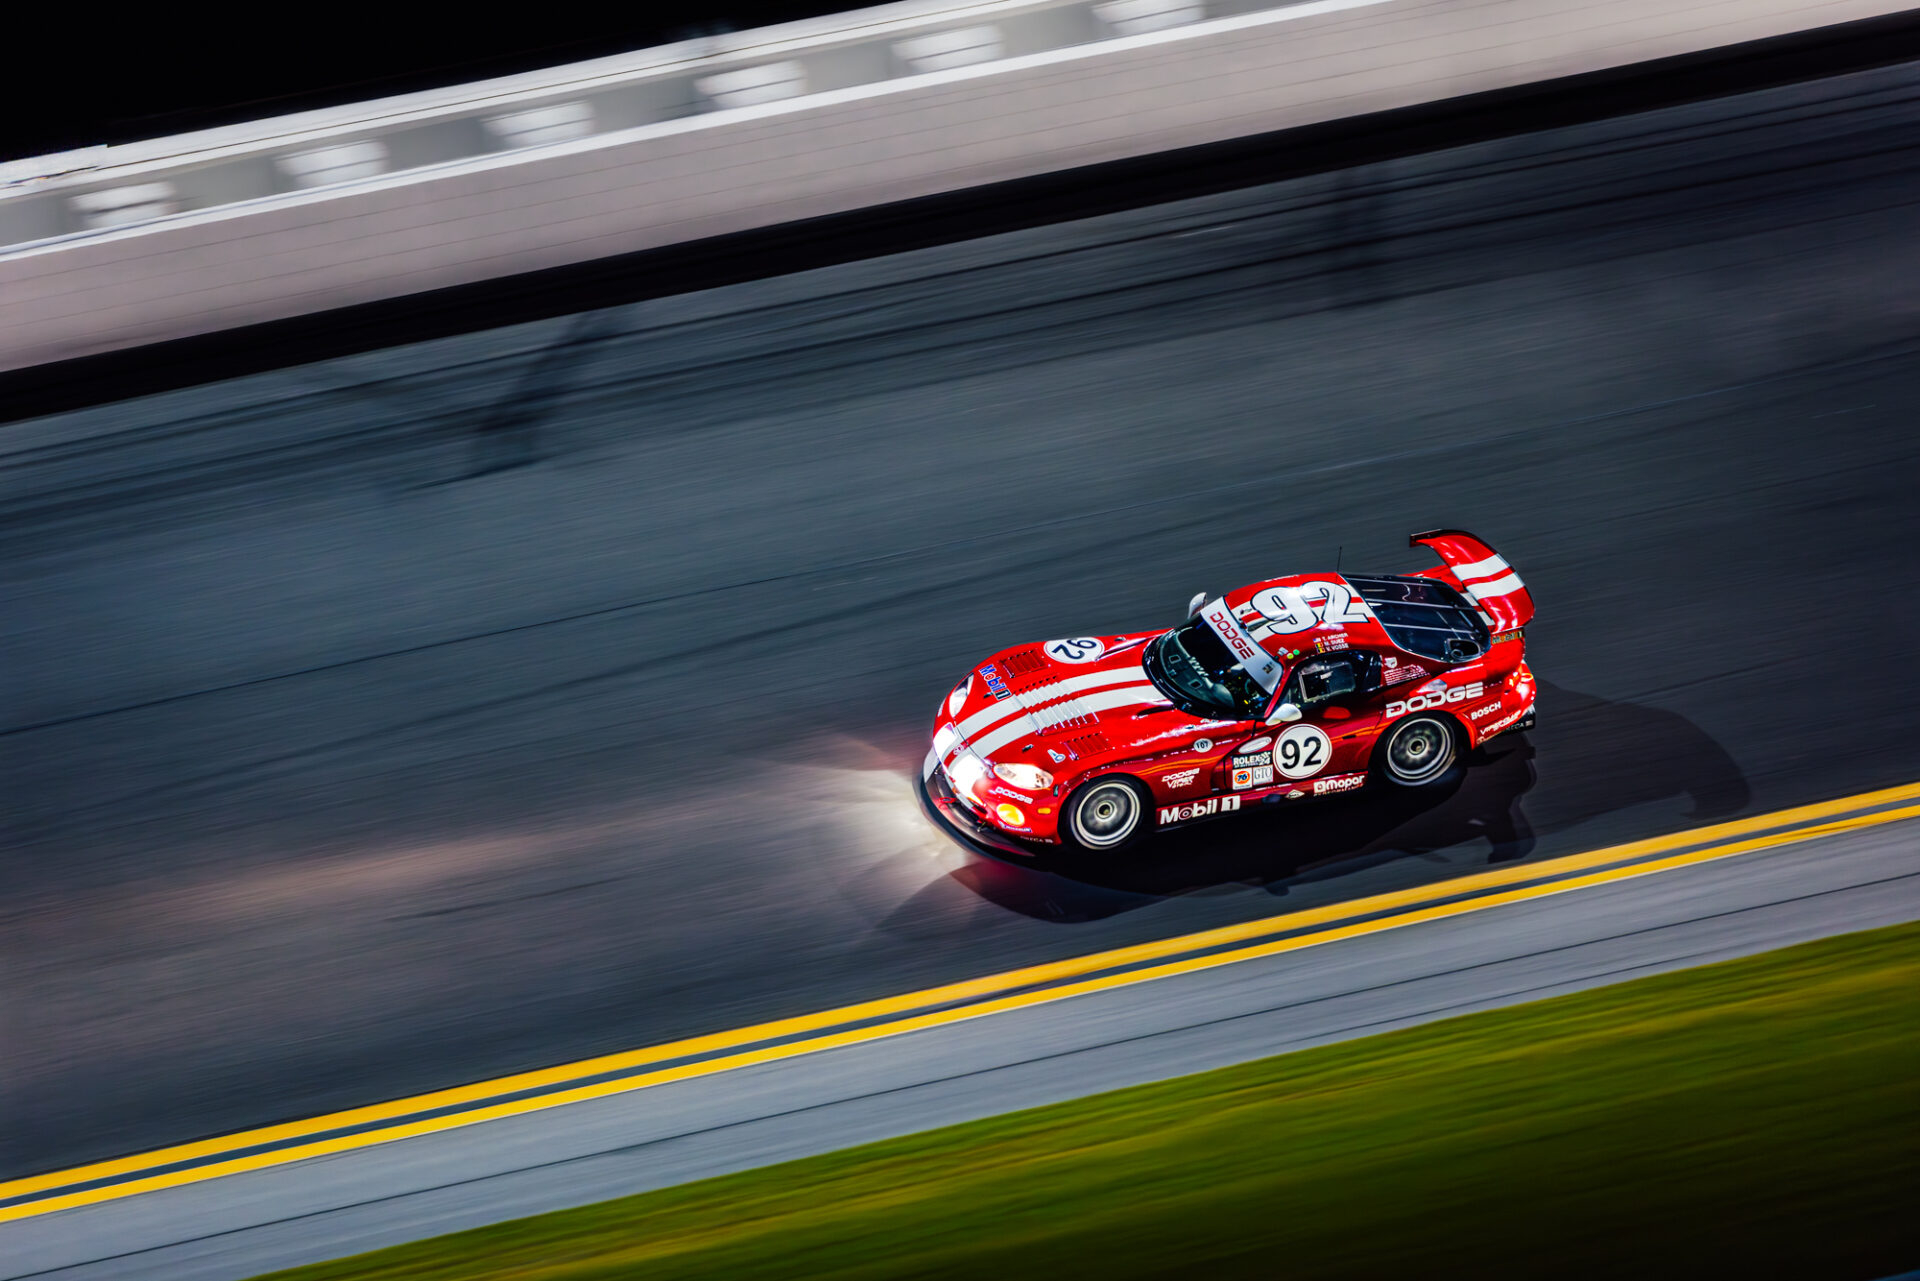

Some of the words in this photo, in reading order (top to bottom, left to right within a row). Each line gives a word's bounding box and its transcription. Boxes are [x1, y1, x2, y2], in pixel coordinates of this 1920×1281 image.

[1250, 580, 1371, 635] 92
[1209, 611, 1255, 660] DODGE
[1051, 639, 1097, 660] 92
[979, 664, 1007, 692] Mobil
[1385, 681, 1483, 718] DODGE
[1470, 701, 1502, 720] BOSCH
[1233, 754, 1262, 767] ROLEX
[1281, 736, 1322, 770] 92
[1161, 768, 1200, 782] DODGE
[1237, 774, 1248, 782] 76
[1254, 766, 1272, 780] GTO
[995, 786, 1034, 804] DODGE
[1160, 799, 1218, 825] Mobil
